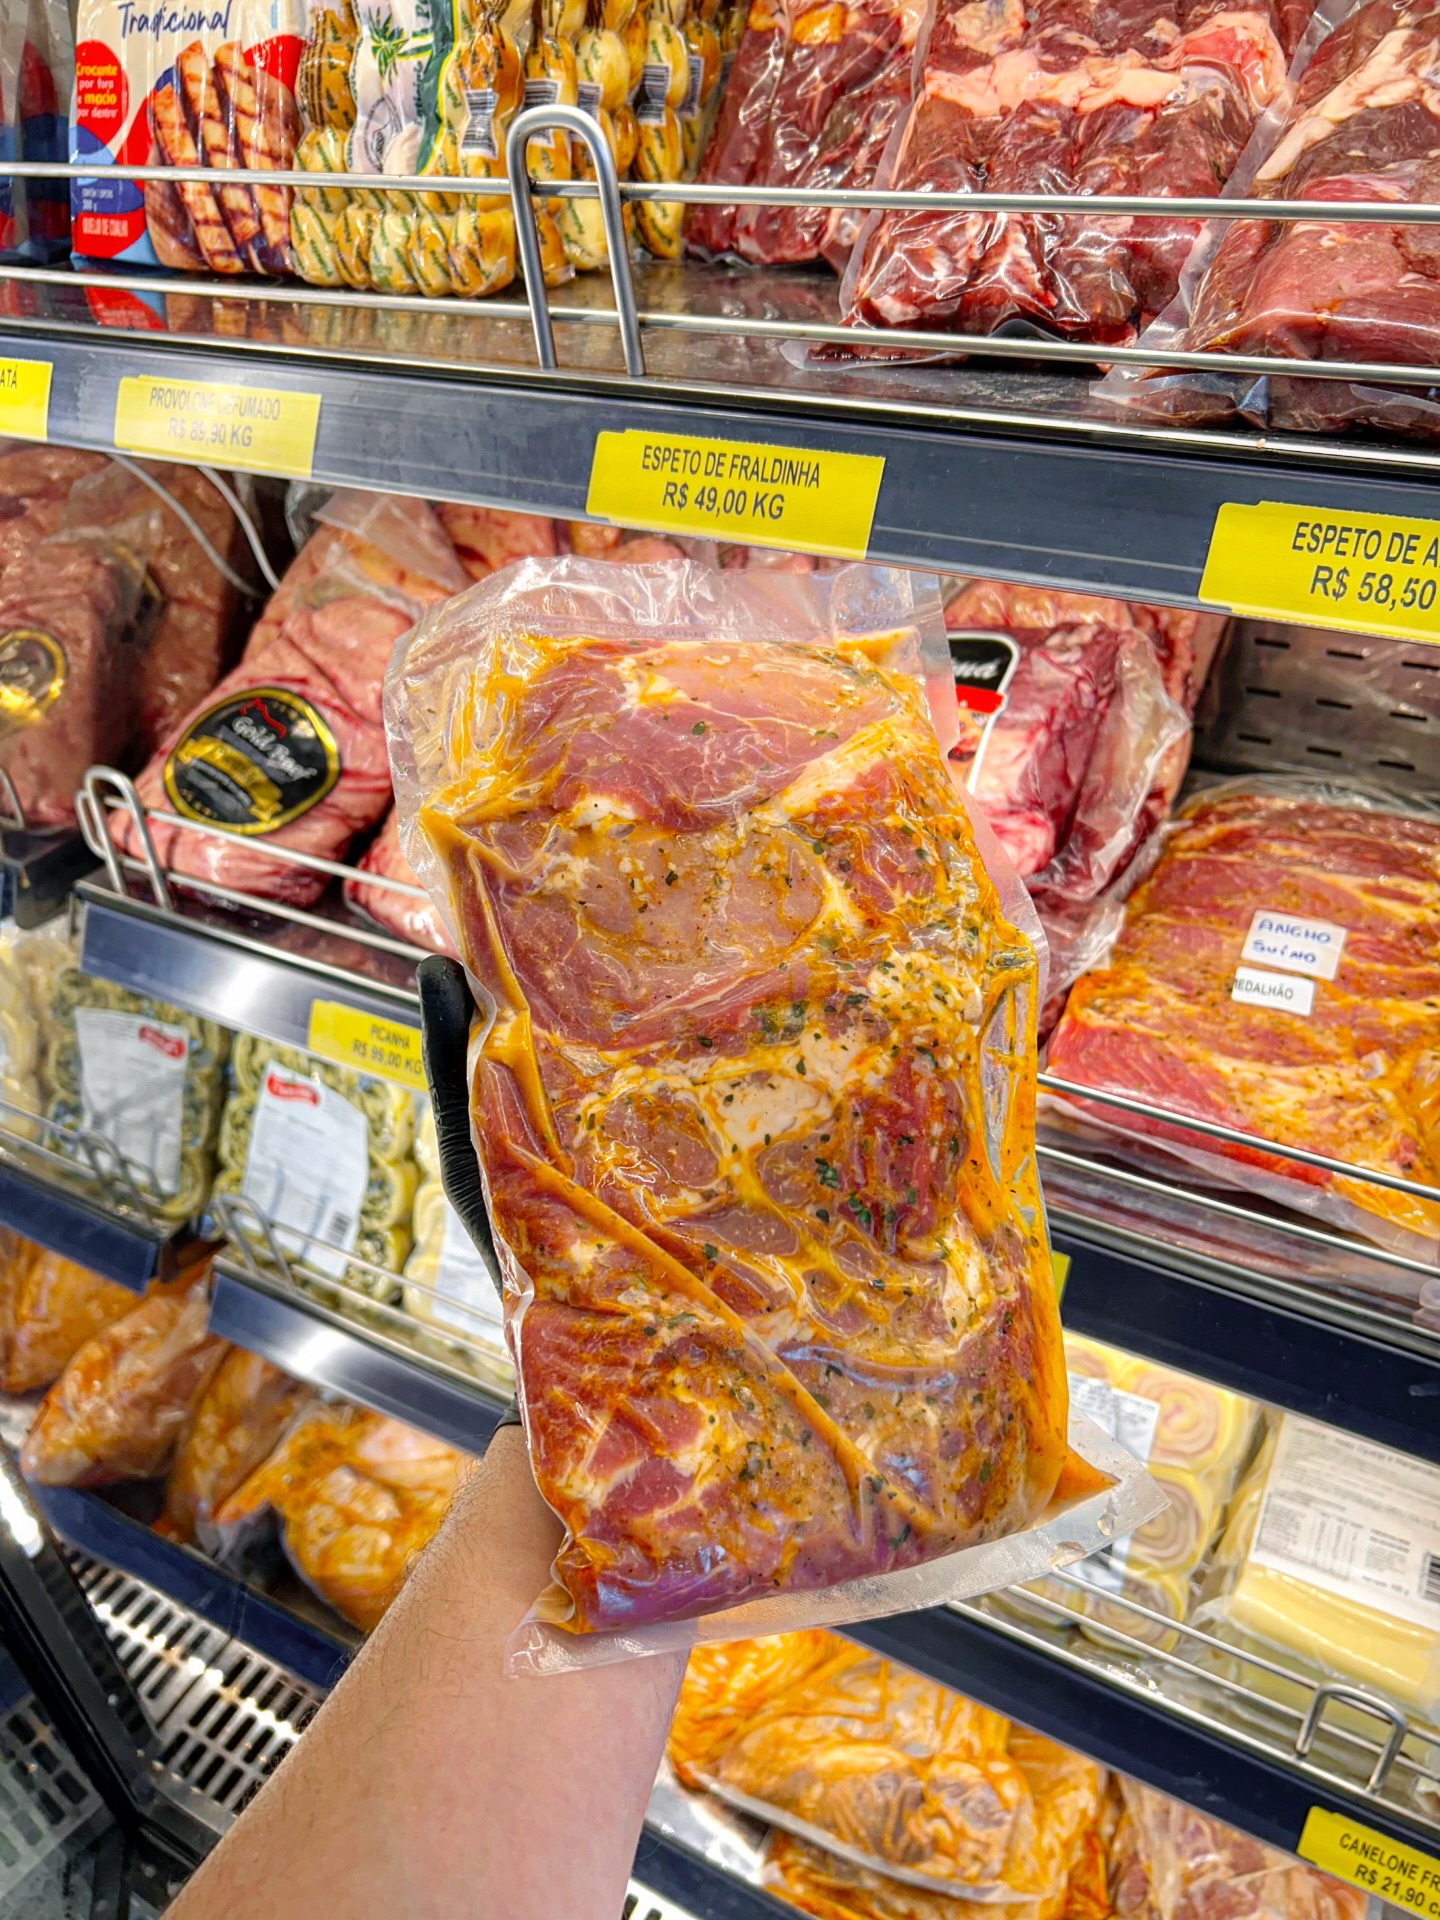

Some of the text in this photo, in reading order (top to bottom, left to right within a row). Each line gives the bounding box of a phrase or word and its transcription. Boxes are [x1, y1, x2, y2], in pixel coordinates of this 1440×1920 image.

[117, 0, 232, 42] Tradicional
[76, 62, 118, 77] Crocante
[79, 77, 114, 93] por fora
[84, 89, 118, 106] macio
[168, 417, 186, 439] R$
[230, 424, 253, 448] KG
[641, 445, 820, 488] ESPETO DE FRALDINHA
[662, 482, 785, 520] R$ 49,00 KG
[1291, 521, 1440, 568] ESPETO DE A
[1310, 564, 1437, 612] R$ 58,50
[232, 715, 277, 751] Gold
[267, 743, 318, 782] Beef
[370, 1023, 410, 1049] PICANHA
[352, 1038, 367, 1058] R$
[404, 1057, 423, 1076] KG
[1339, 1833, 1419, 1880] CANELONE
[1354, 1864, 1378, 1886] R$
[1381, 1876, 1426, 1907] 21,90
